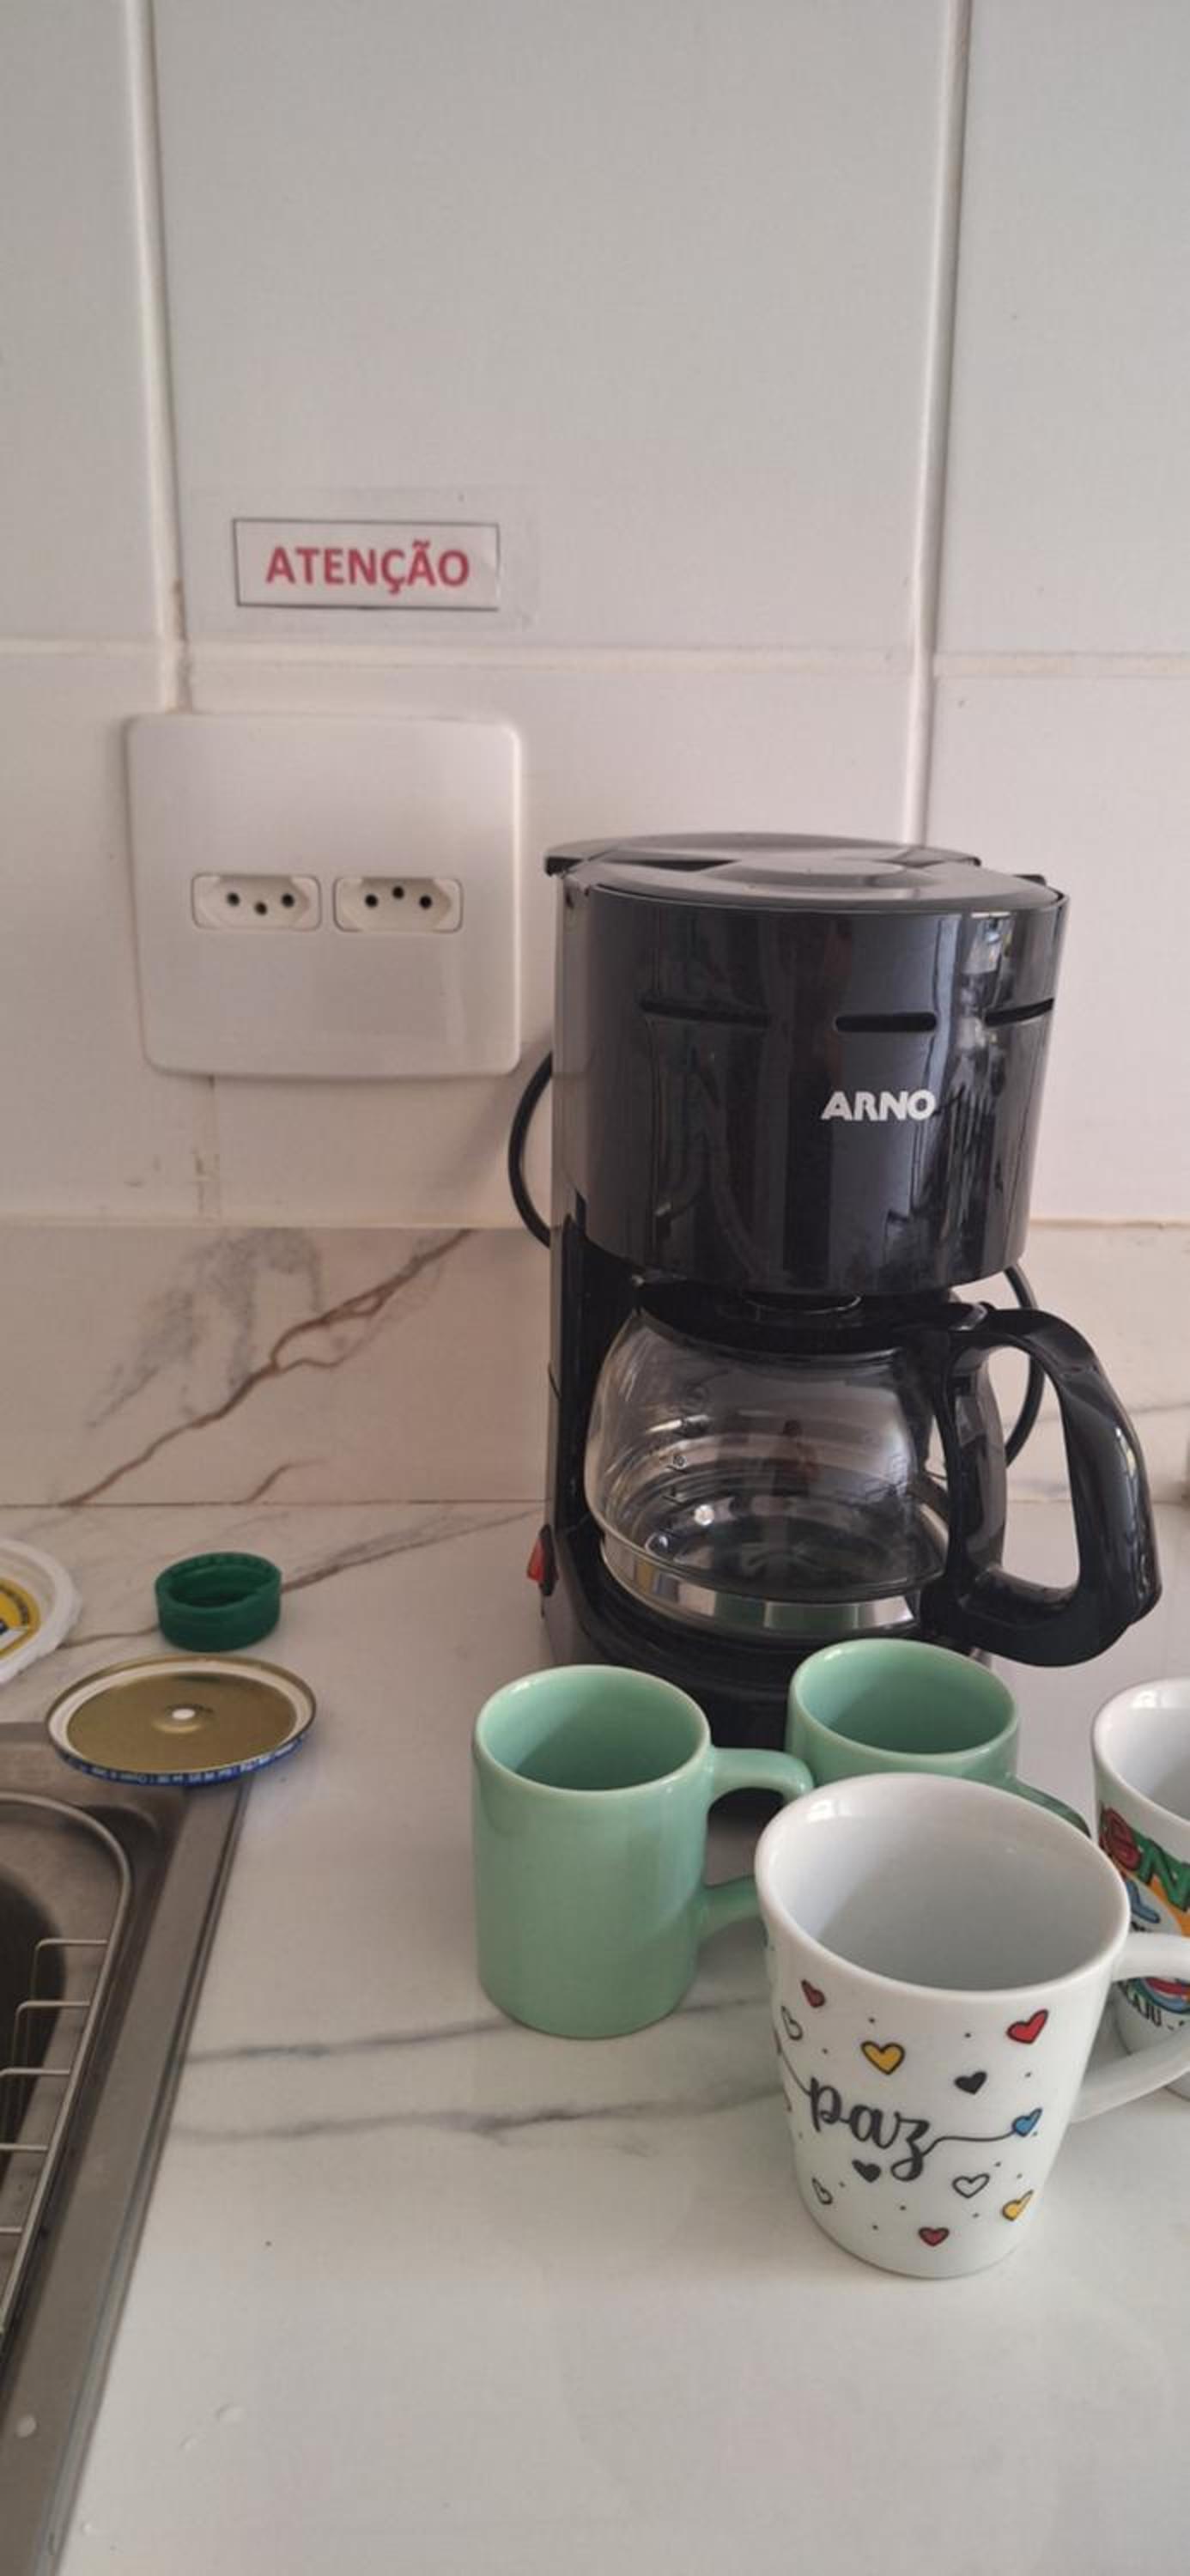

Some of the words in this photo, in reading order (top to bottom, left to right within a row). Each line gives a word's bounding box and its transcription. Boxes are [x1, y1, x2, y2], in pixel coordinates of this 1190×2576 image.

[266, 539, 471, 594] ATENÇÃO
[821, 1090, 936, 1121] ARNO
[811, 2077, 930, 2182] paz
